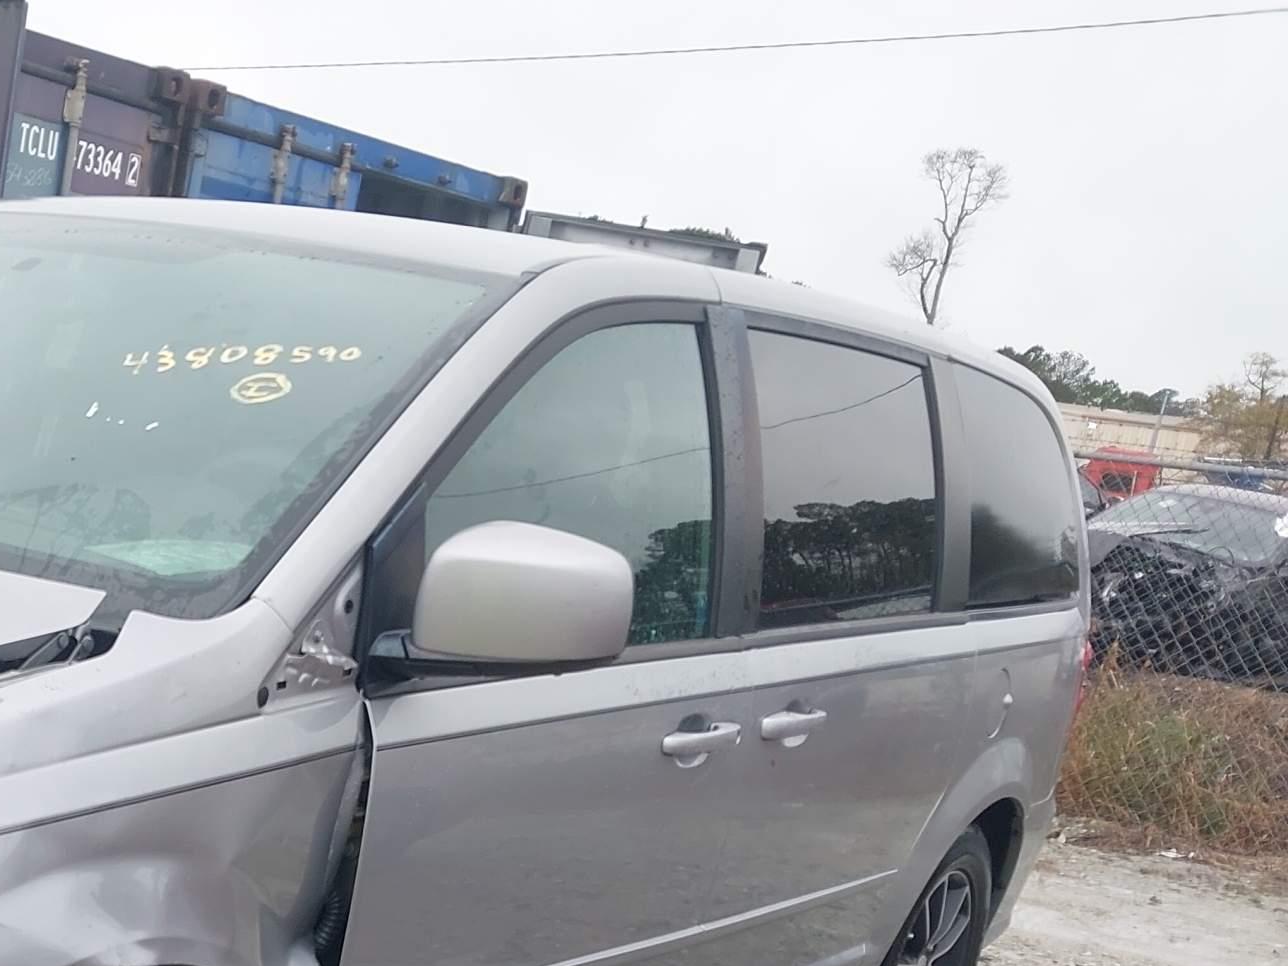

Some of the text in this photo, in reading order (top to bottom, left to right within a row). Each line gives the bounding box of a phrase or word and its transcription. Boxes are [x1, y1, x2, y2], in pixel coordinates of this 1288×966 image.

[19, 122, 60, 160] TCLU
[74, 140, 123, 180] 73364
[123, 344, 362, 374] 43808590
